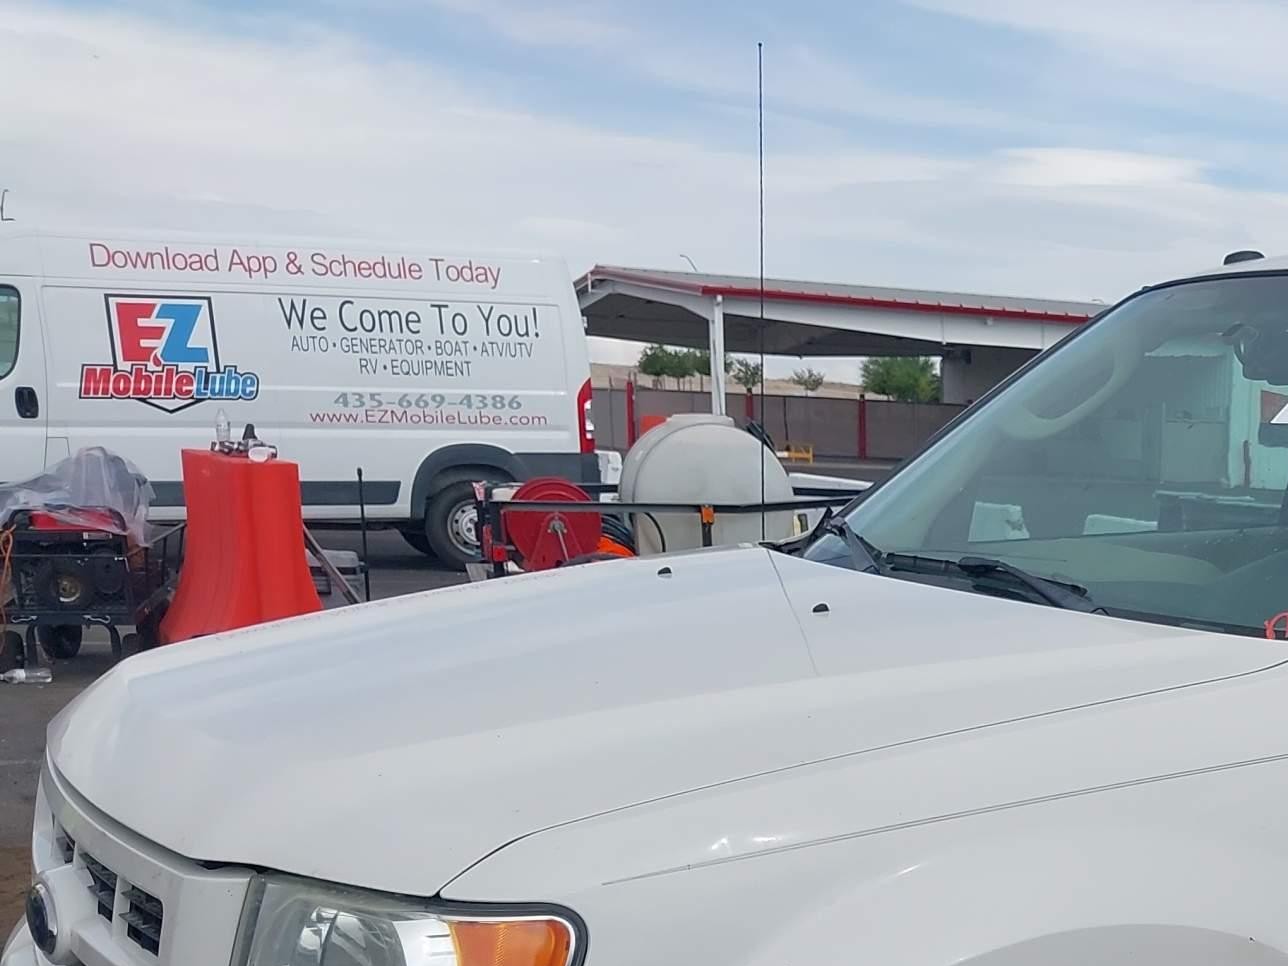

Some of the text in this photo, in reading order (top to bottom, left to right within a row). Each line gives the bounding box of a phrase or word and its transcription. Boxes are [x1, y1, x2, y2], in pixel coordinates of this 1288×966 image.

[89, 243, 500, 290] Download App & Schedule Today
[278, 297, 539, 338] We Come To You!
[115, 302, 210, 363] EZ
[291, 336, 533, 358] AUTO GENERATOR BOAT ATV/UTV
[359, 358, 471, 376] RV EQUIPMENT
[80, 365, 258, 399] MobileLube
[334, 392, 522, 410] 435-669-4386
[310, 409, 547, 425] www.EZMobileLube.com
